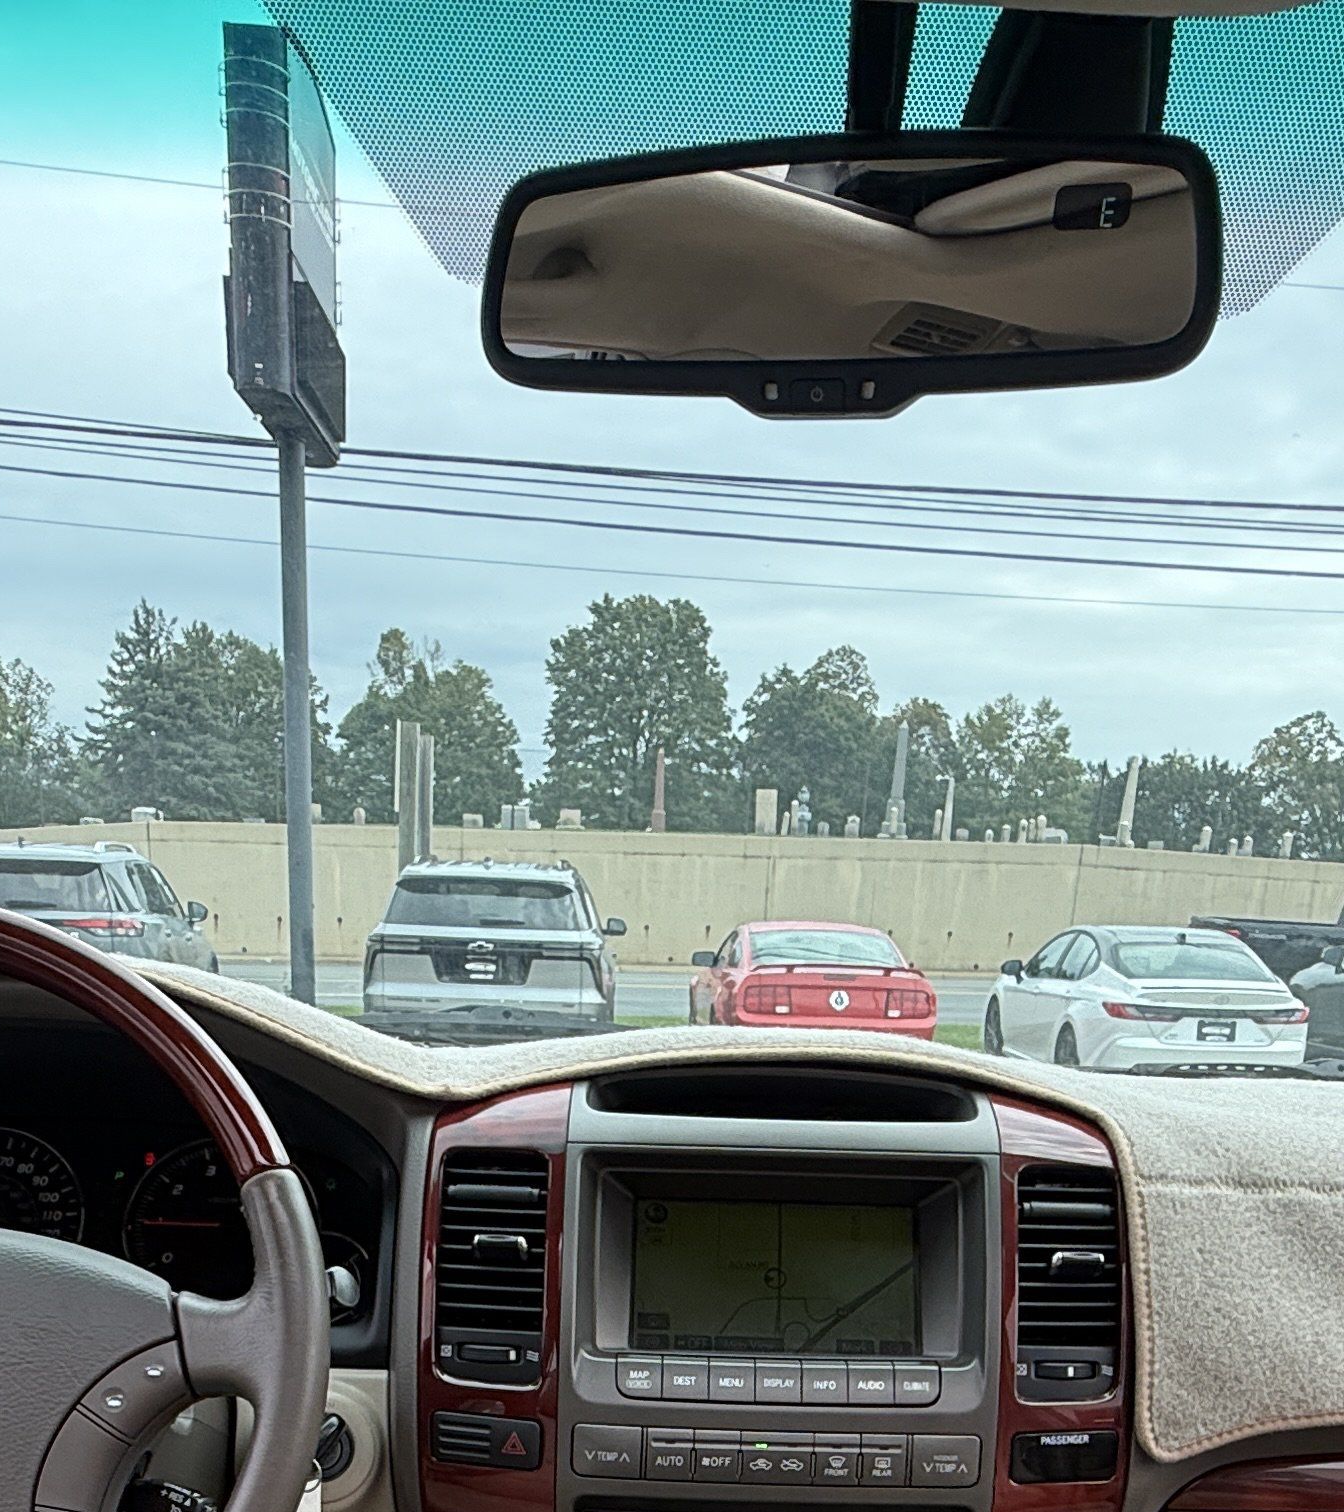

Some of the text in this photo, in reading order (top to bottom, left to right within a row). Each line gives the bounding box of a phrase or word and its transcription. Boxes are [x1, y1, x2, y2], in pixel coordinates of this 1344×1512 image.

[1099, 196, 1116, 229] E
[17, 1163, 35, 1174] 80
[204, 1164, 217, 1177] 3
[32, 1175, 49, 1187] 90
[171, 1183, 184, 1196] 2
[37, 1192, 60, 1203] 100
[41, 1210, 64, 1222] 110
[160, 1251, 174, 1264] 0
[629, 1370, 650, 1379] MAP
[673, 1375, 697, 1386] DEST
[718, 1377, 744, 1388] MENU
[763, 1378, 795, 1389] DISPLAY
[813, 1380, 837, 1390] INFO
[857, 1380, 885, 1391] AUDIO
[1040, 1434, 1090, 1446] PASSENGER
[655, 1456, 684, 1467] AUTO
[710, 1456, 733, 1468] OFF
[823, 1468, 849, 1477] FRONT
[871, 1468, 893, 1477] REAR
